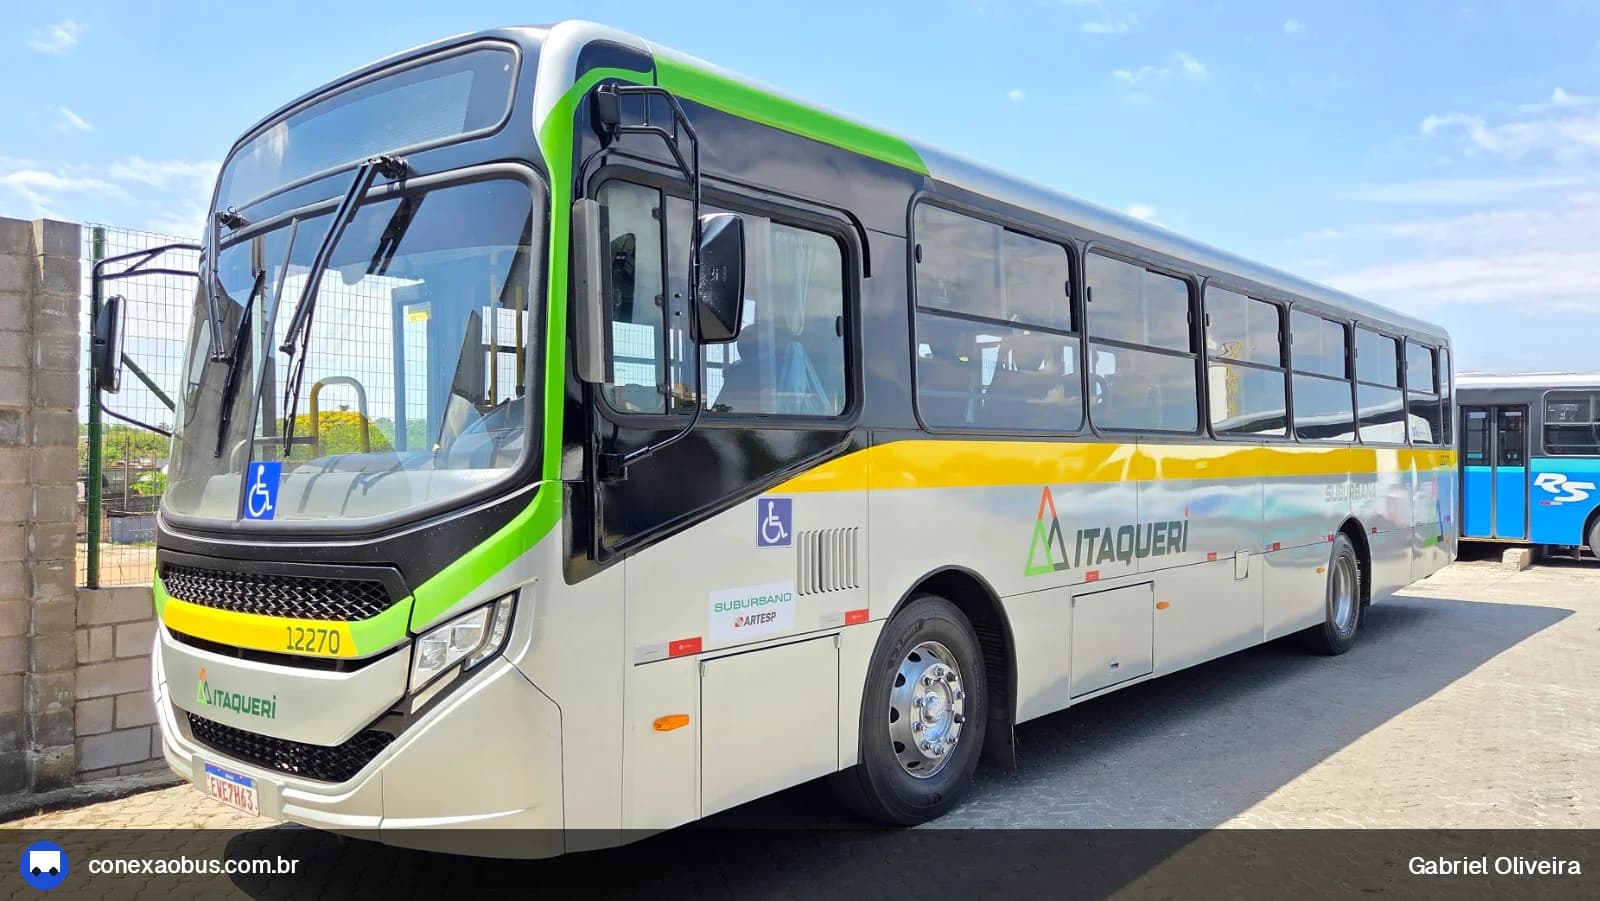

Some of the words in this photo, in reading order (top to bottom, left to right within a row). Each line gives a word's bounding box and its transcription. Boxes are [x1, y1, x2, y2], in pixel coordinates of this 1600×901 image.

[1533, 472, 1597, 503] RS
[714, 592, 792, 613] SUBURBANO
[743, 611, 777, 628] ARTESP
[286, 626, 340, 655] 12270
